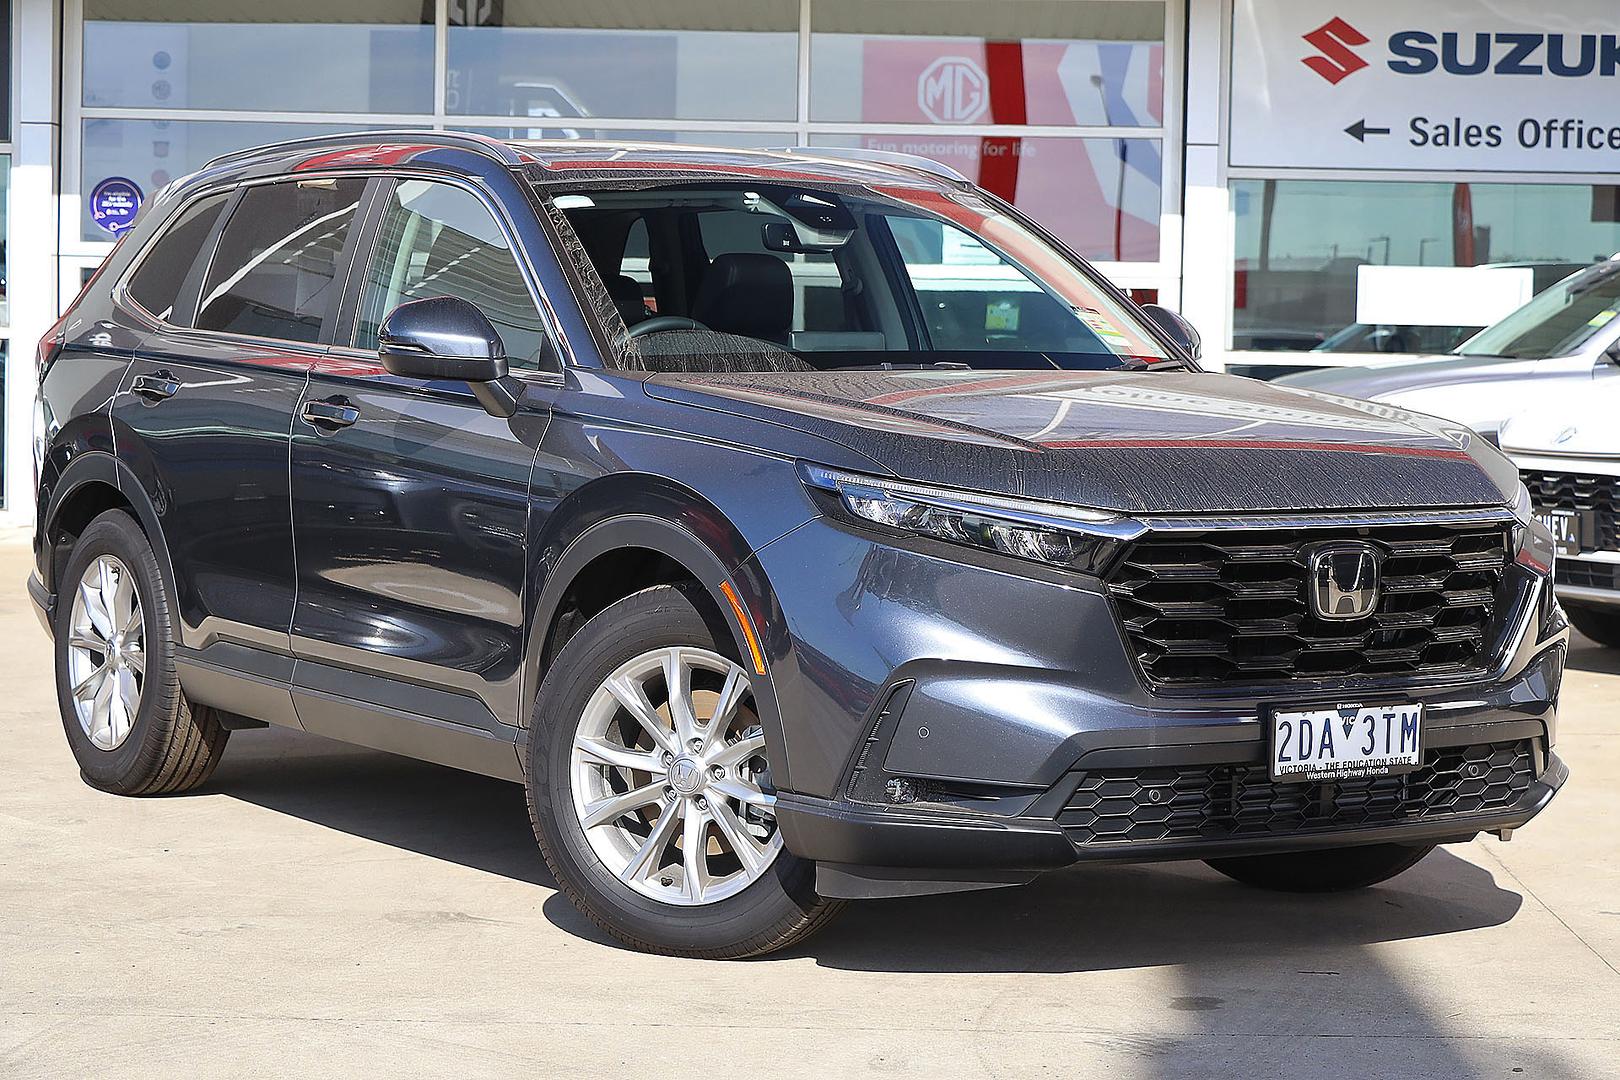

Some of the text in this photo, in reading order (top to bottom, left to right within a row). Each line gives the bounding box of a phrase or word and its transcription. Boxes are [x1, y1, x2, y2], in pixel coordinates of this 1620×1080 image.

[925, 64, 980, 120] MG
[1409, 117, 1620, 149] Sales Office
[868, 138, 1038, 160] Fun motoring for life
[1278, 712, 1418, 763] 2DA 3TM
[1280, 763, 1317, 774] VICTORIA
[1325, 761, 1340, 770] THE
[1342, 758, 1387, 769] EDUCATION
[1389, 755, 1412, 766] STATE
[1306, 766, 1389, 780] Western Highway Honda
